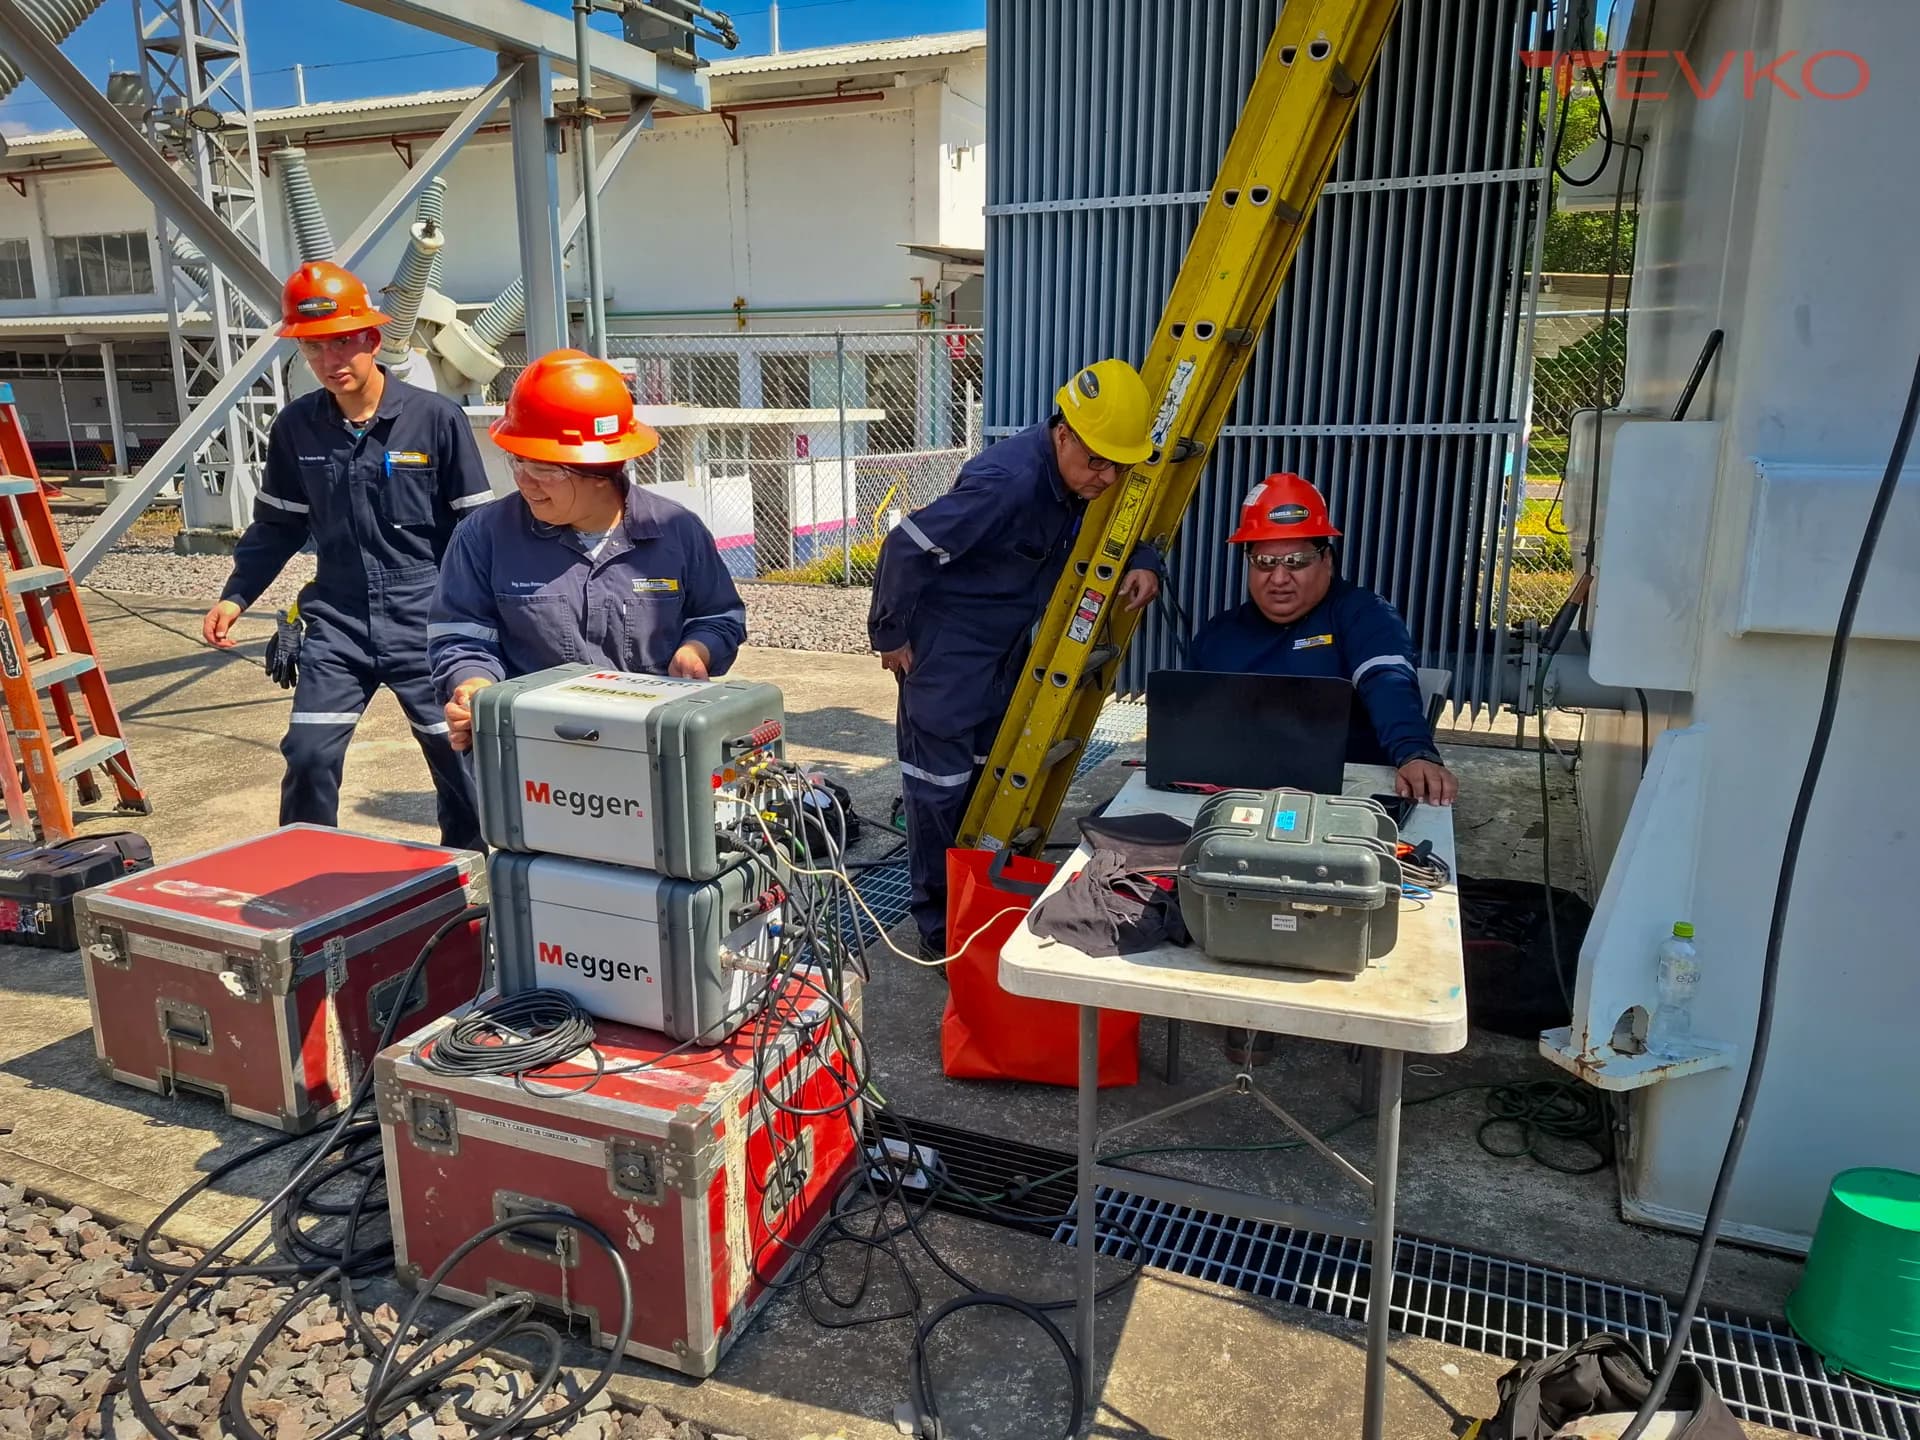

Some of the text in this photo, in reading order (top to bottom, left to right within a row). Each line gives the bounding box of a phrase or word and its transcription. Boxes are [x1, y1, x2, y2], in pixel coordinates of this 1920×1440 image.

[587, 673, 702, 688] Megger
[525, 780, 640, 818] Megger
[538, 941, 649, 982] Megger
